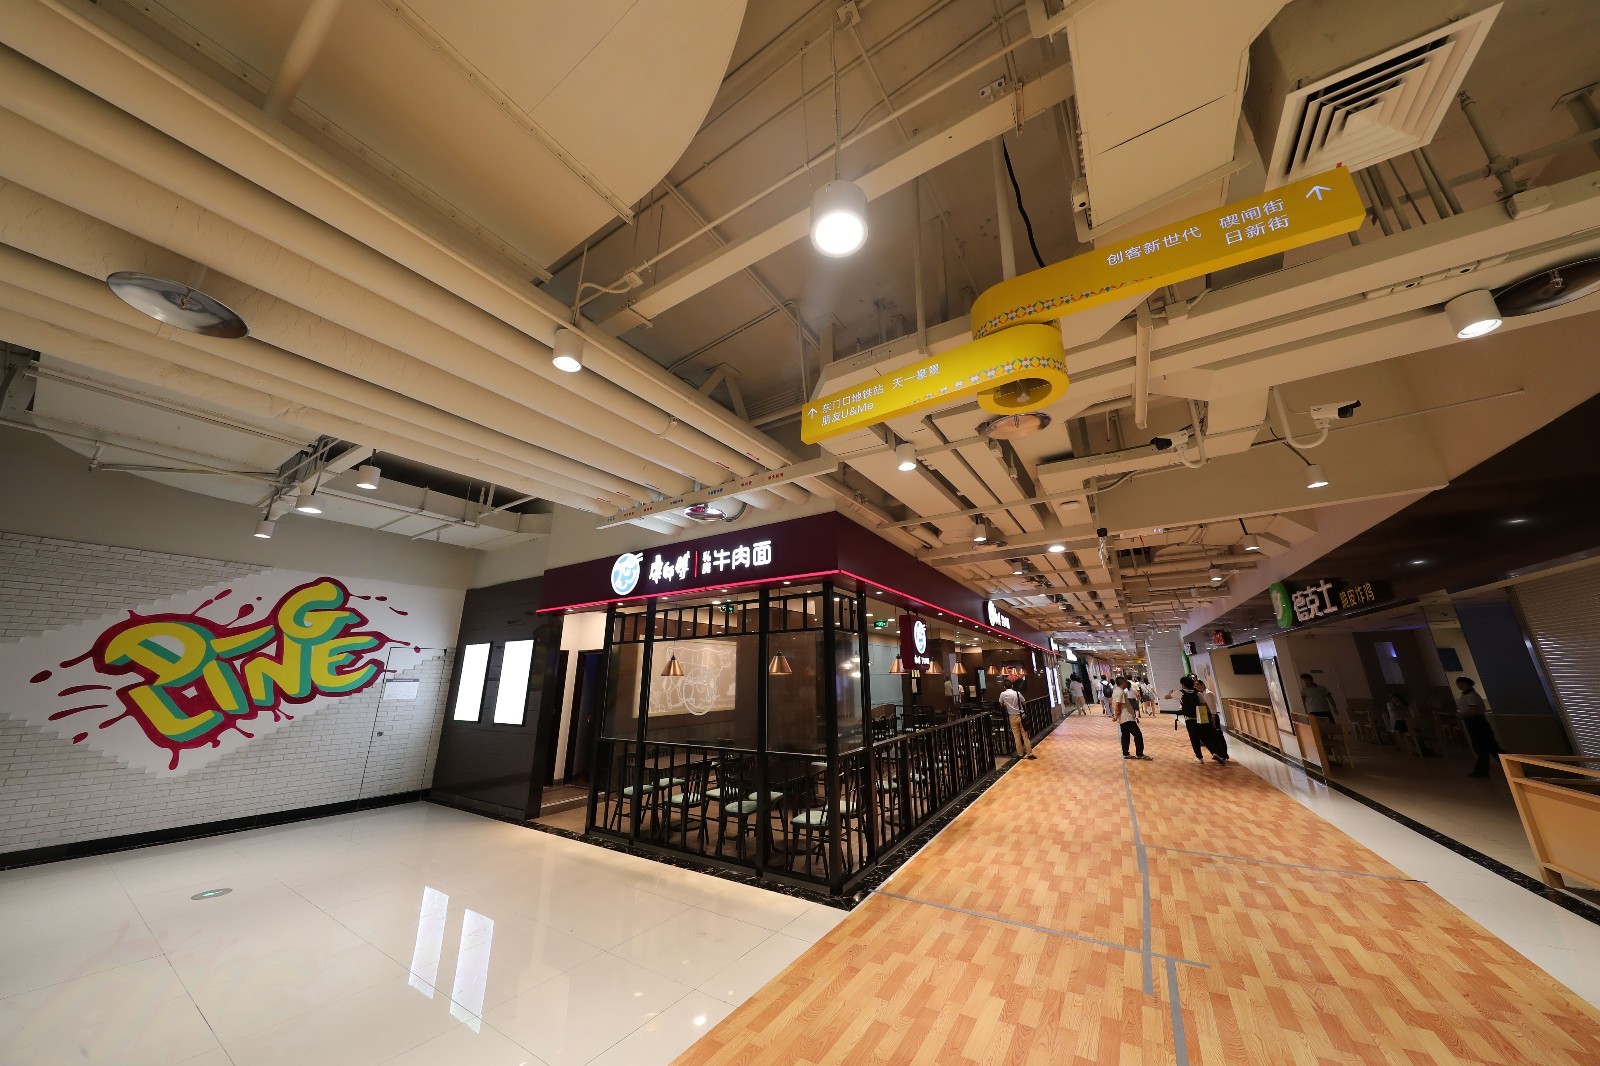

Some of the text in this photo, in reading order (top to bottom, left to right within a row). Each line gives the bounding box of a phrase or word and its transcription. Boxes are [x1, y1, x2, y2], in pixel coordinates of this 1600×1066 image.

[1225, 214, 1289, 245] 日新街
[1106, 226, 1202, 266] 创客新世代
[822, 384, 884, 413] 东门口地铁站
[712, 540, 772, 572] 牛肉面
